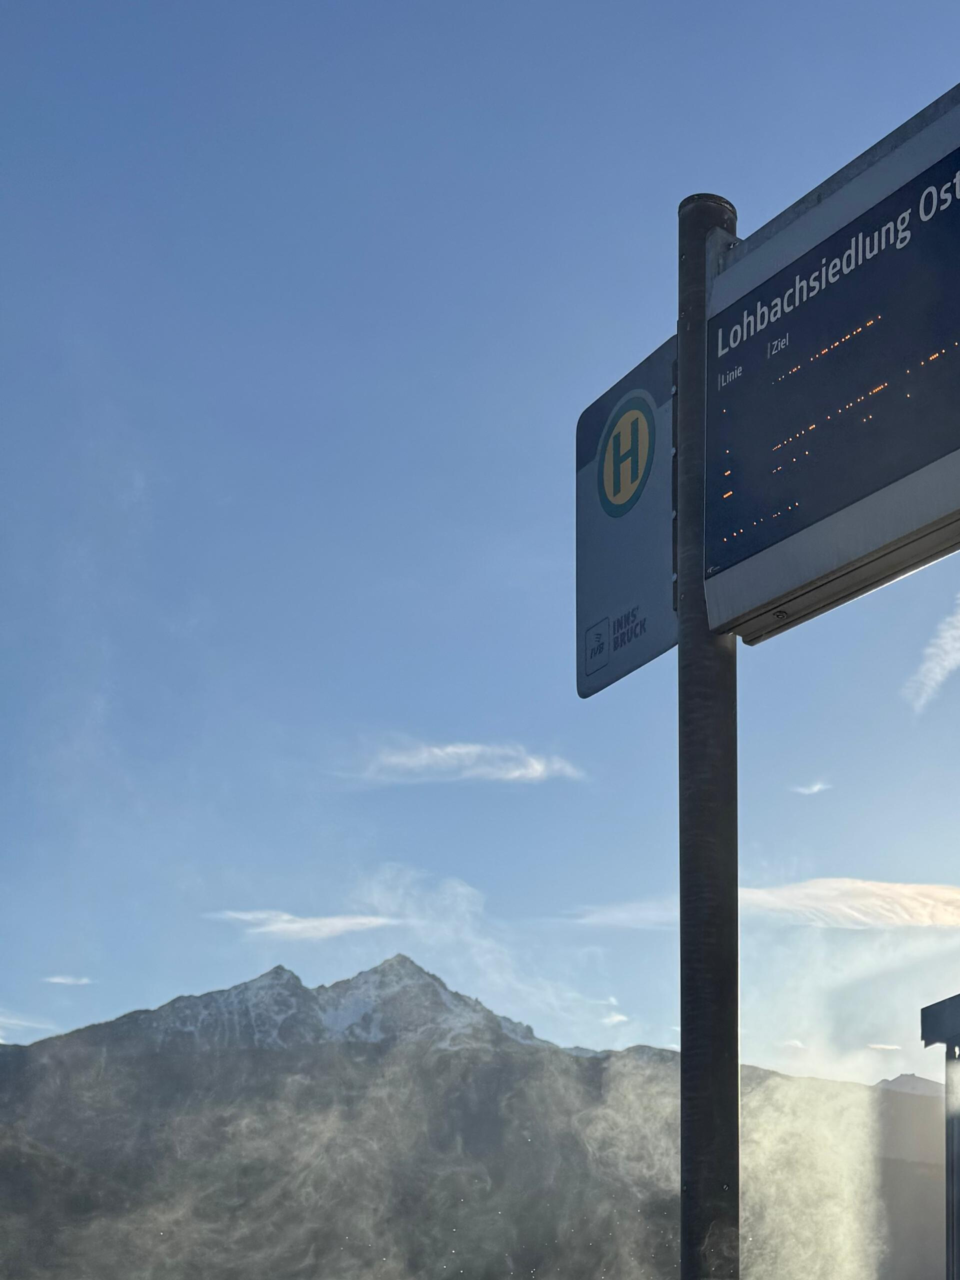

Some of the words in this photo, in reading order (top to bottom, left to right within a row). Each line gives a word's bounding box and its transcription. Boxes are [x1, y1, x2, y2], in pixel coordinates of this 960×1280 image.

[717, 207, 912, 358] Lohbachsiedlung
[771, 333, 789, 356] Ziel
[721, 365, 743, 387] Linie
[613, 617, 647, 651] BRUCK
